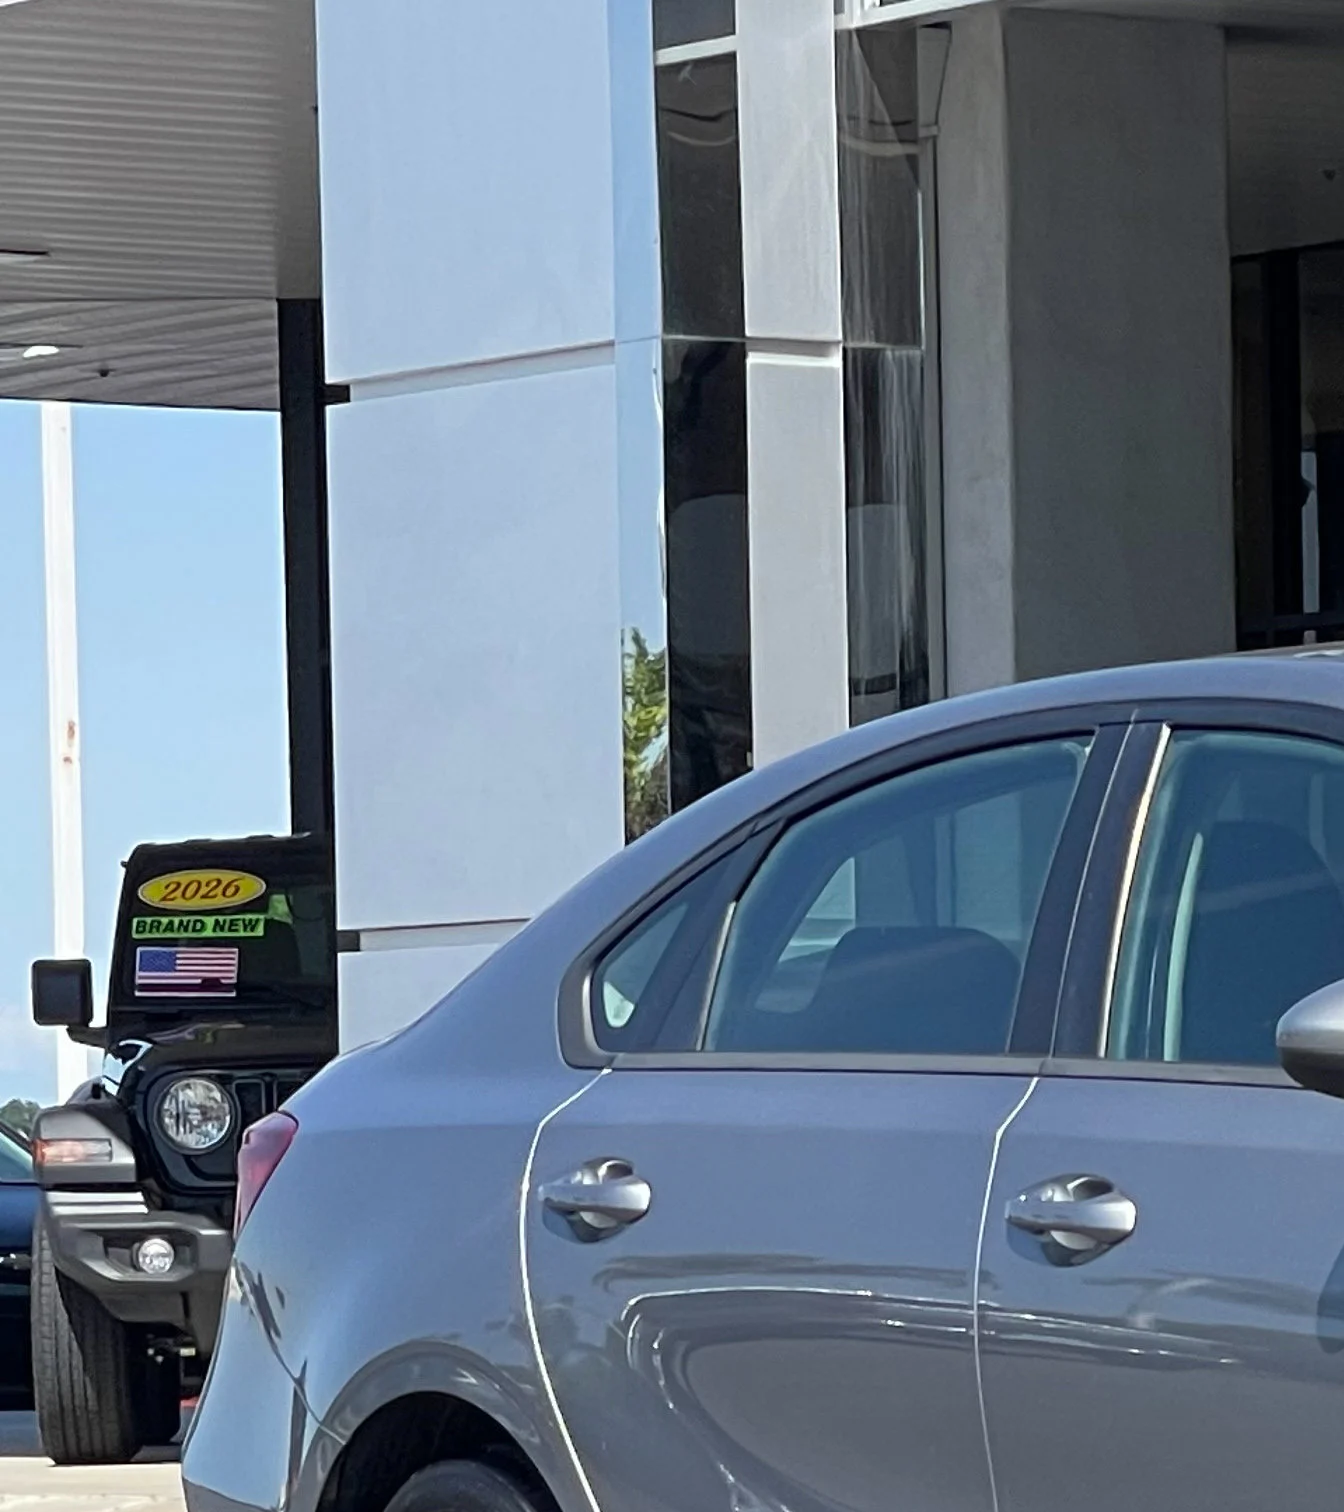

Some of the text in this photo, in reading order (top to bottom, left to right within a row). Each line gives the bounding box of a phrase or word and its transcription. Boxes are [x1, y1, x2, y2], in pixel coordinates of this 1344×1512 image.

[160, 876, 245, 902] 2026
[135, 917, 260, 934] BRAND NEW
